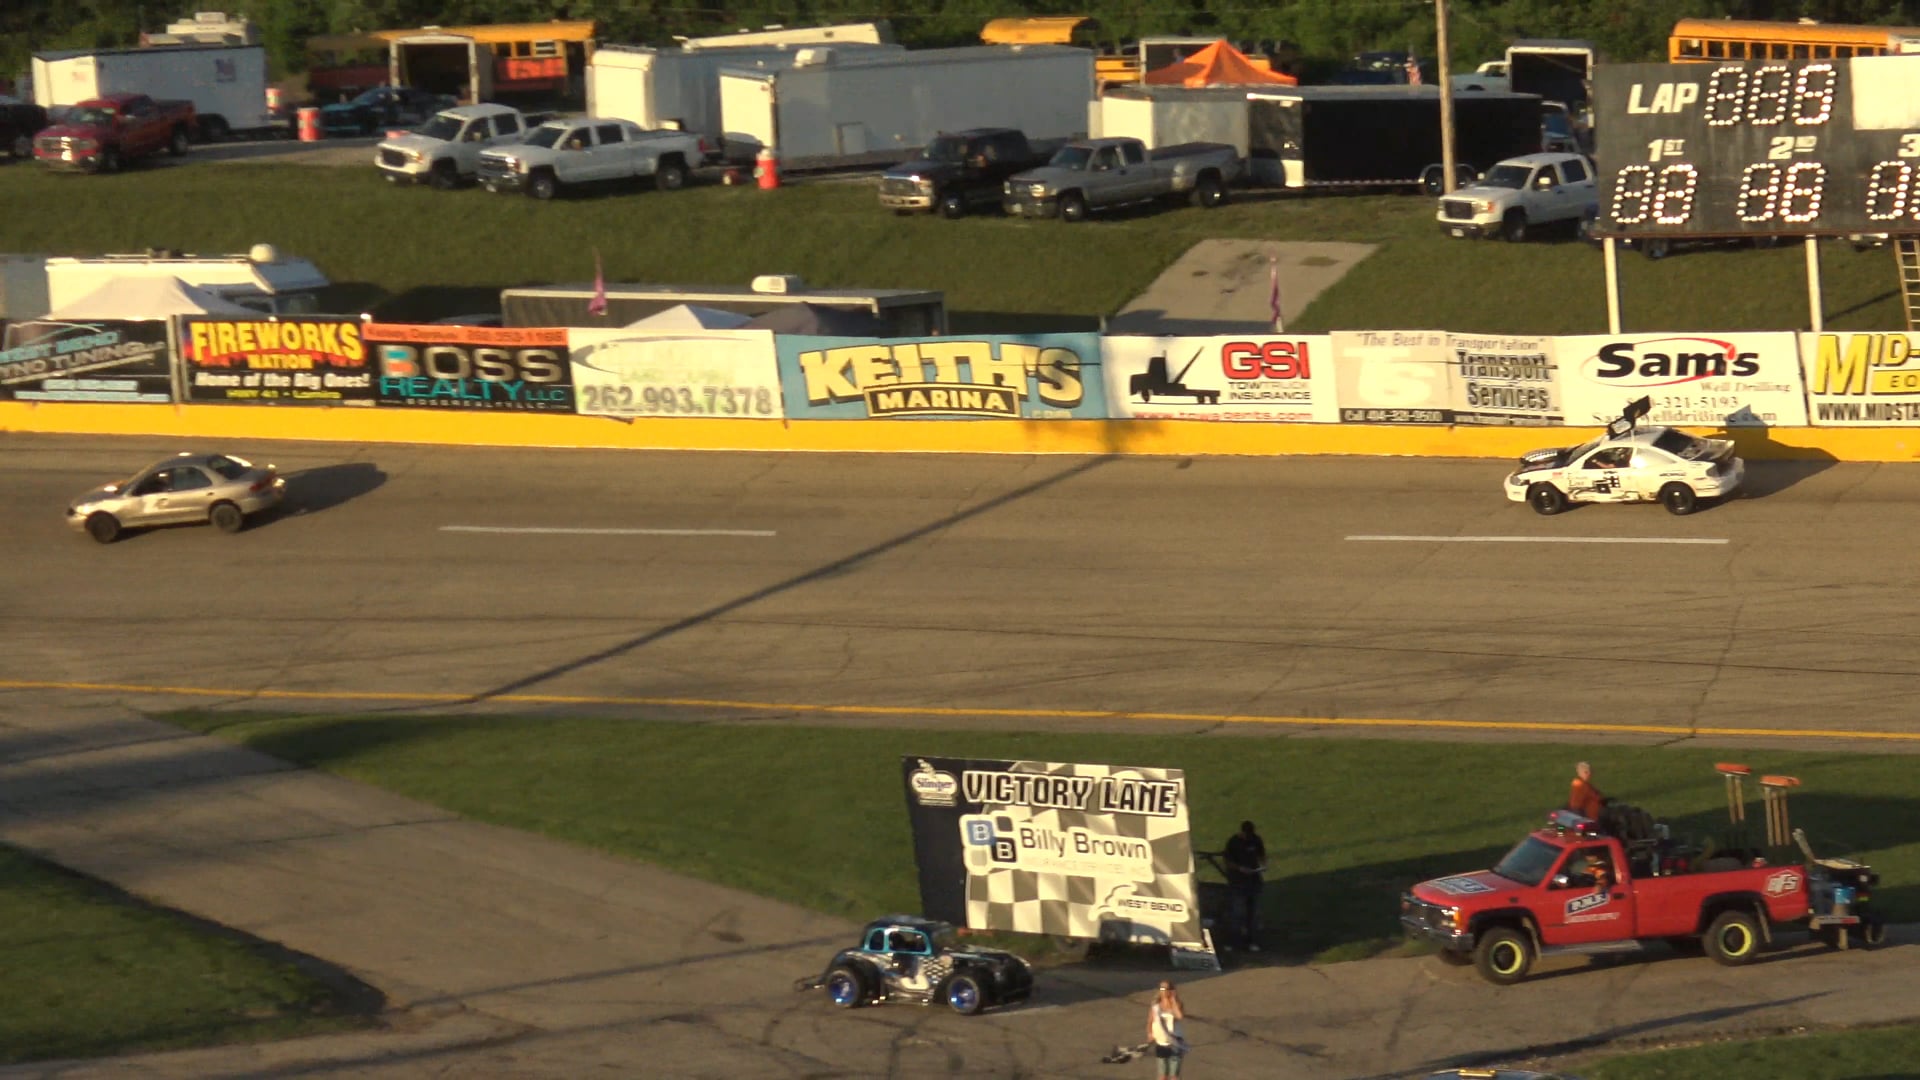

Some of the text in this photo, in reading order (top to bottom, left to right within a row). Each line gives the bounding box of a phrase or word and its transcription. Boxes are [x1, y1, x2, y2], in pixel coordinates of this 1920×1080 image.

[1627, 82, 1699, 114] LAP
[190, 322, 364, 361] FIREWORKS
[1393, 333, 1422, 346] Best
[1428, 335, 1441, 346] in
[51, 341, 146, 369] TUNING
[247, 354, 313, 369] NATION
[378, 345, 562, 382] BOSS
[1221, 341, 1311, 379] GSI
[1456, 350, 1552, 380] Transport
[195, 372, 241, 386] Home
[243, 373, 262, 387] of
[263, 373, 291, 387] the
[294, 373, 321, 390] Big
[380, 376, 565, 400] REALTY LLC
[800, 342, 1083, 408] KEITH'S
[1701, 382, 1791, 393] Well Drilling
[582, 385, 772, 414] 262.993.7378
[877, 389, 1009, 411] MARINA
[1229, 391, 1311, 400] INSURANCE
[1468, 382, 1549, 409] Services
[963, 771, 1179, 816] VICTORY LANE
[972, 824, 990, 841] B
[1020, 827, 1147, 859] Billy Brown
[996, 842, 1013, 859] B
[1119, 899, 1184, 912] WEST BEND
